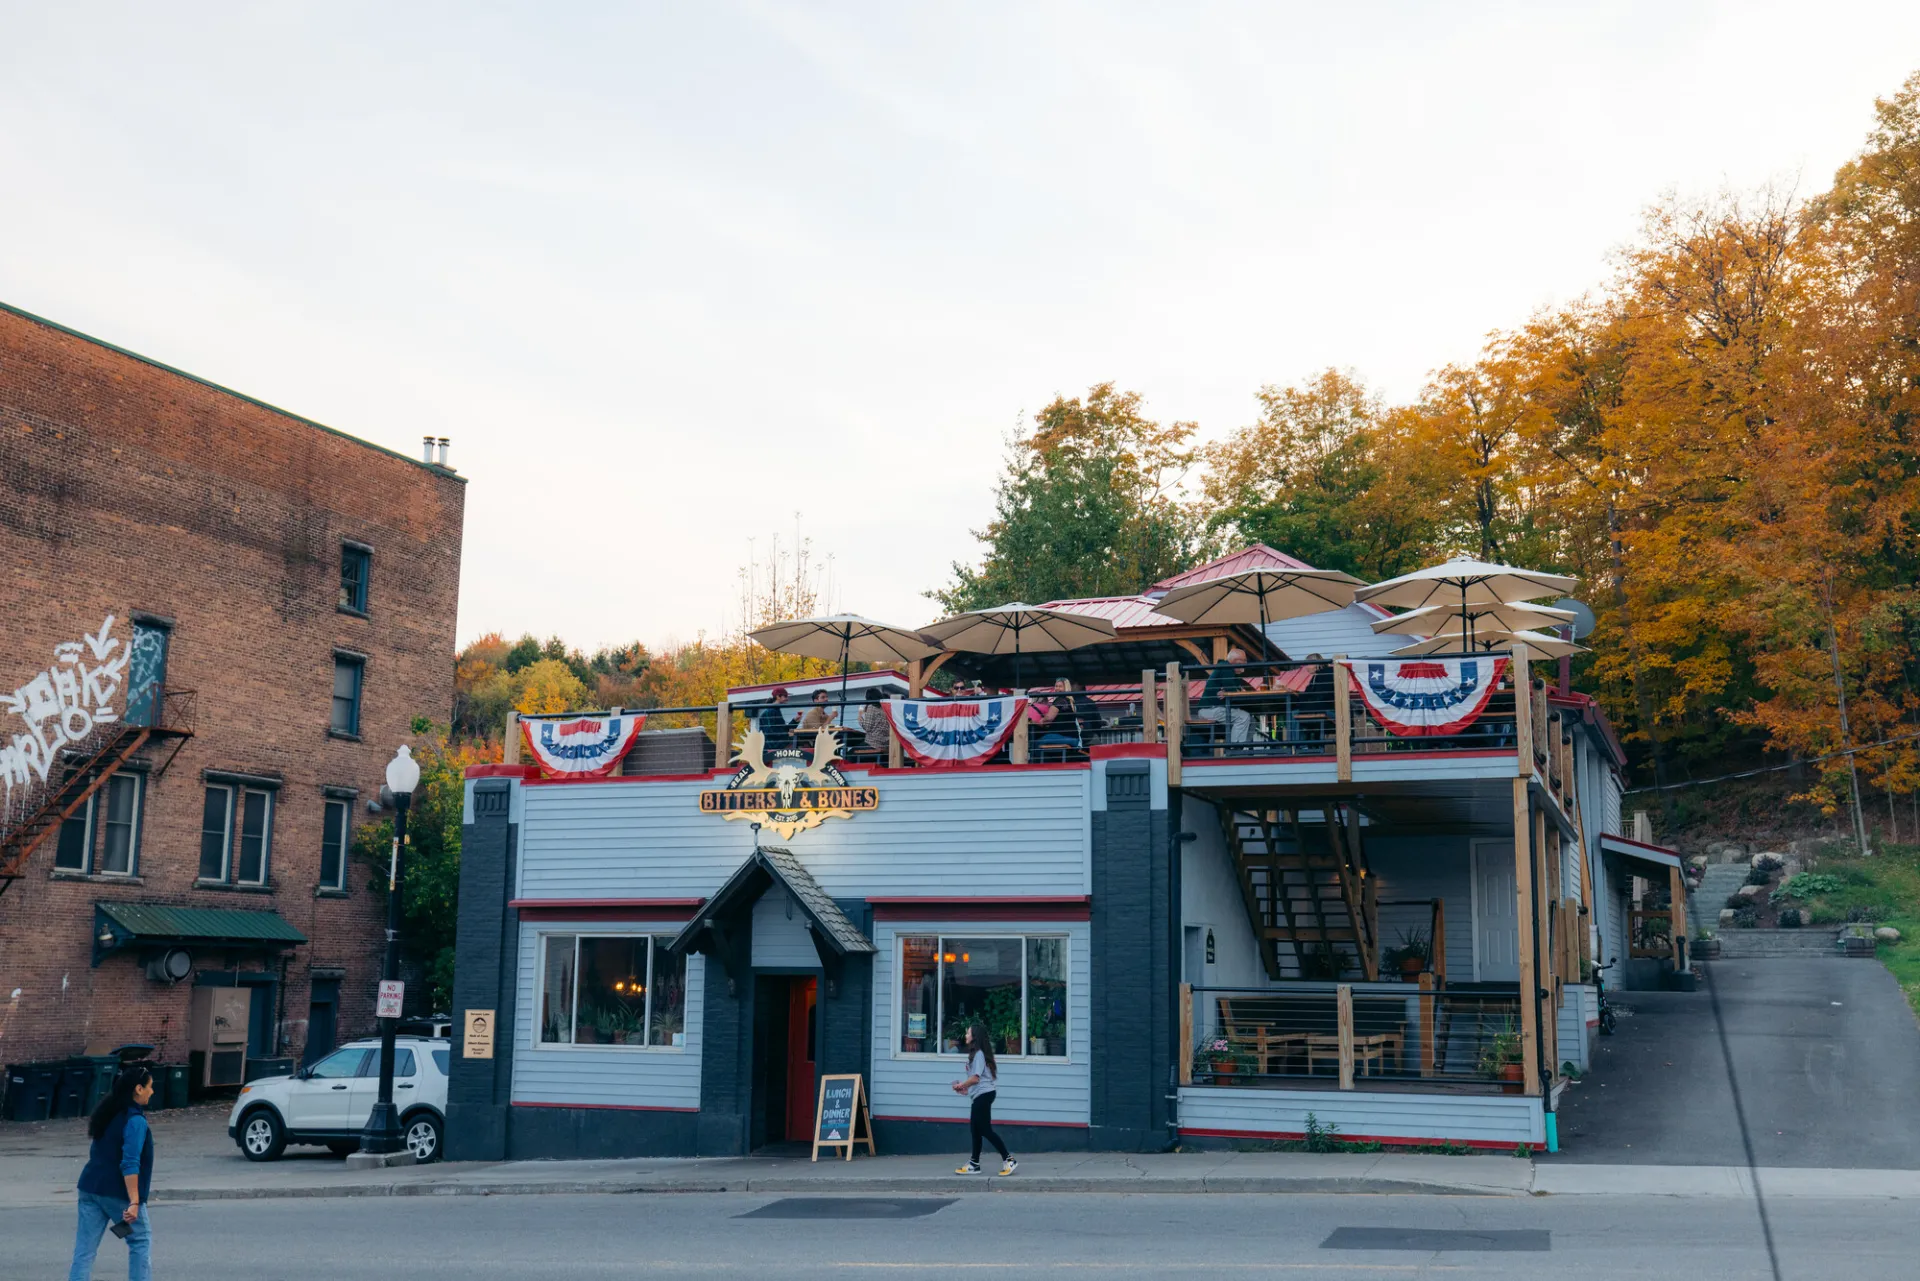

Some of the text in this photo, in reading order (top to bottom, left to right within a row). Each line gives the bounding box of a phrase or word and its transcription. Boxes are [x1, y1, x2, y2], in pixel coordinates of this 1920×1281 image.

[731, 749, 845, 788] REAL HOME TOWN
[703, 788, 875, 810] BITTERS & BONES
[387, 984, 396, 992] NO
[379, 992, 402, 1000] PARKING
[826, 1088, 852, 1099] LUNCH
[835, 1099, 841, 1108] &
[823, 1108, 851, 1120] DINNER
